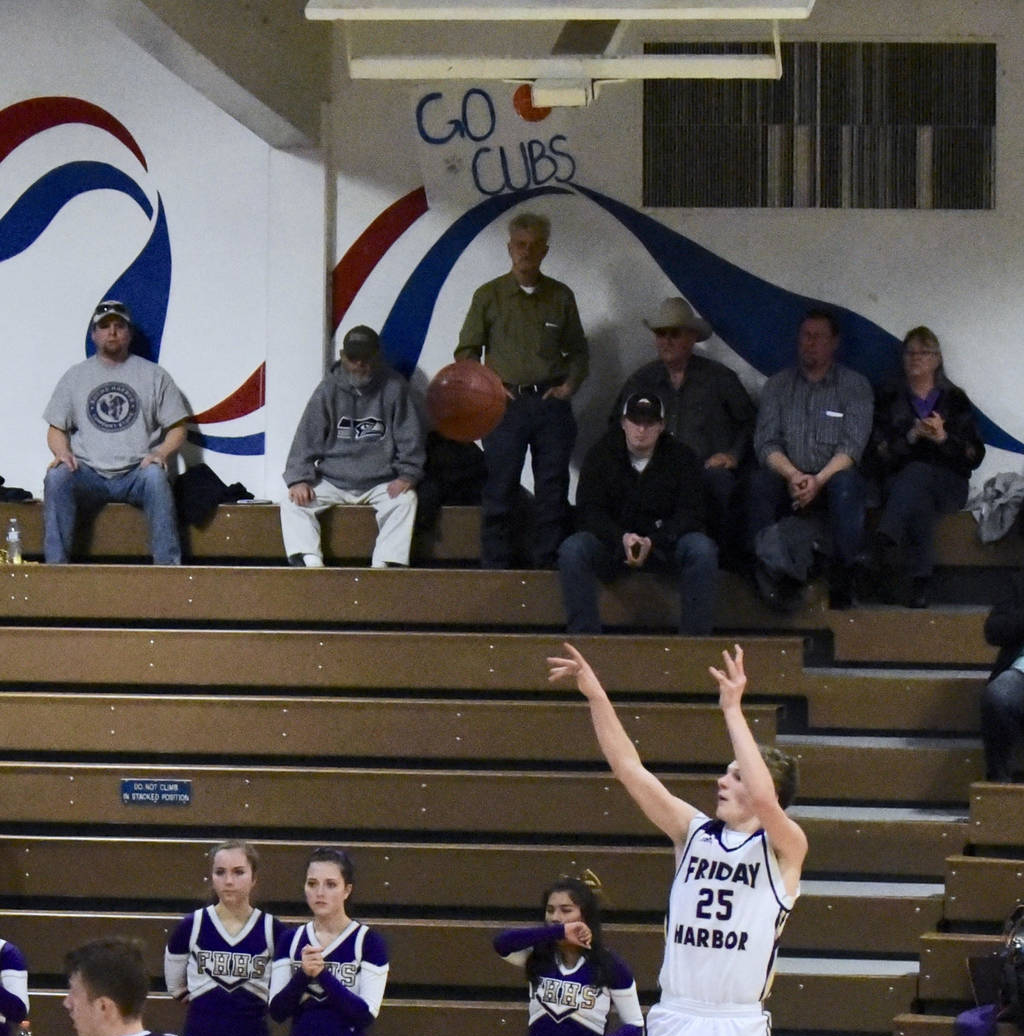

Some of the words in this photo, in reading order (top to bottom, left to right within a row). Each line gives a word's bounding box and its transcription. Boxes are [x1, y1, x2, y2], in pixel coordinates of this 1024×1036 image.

[416, 88, 496, 144] GO
[472, 134, 575, 195] CUBS
[684, 856, 761, 888] FRIDAY
[696, 888, 734, 921] 25
[674, 924, 749, 951] HARBOR
[196, 951, 268, 979] FHHS
